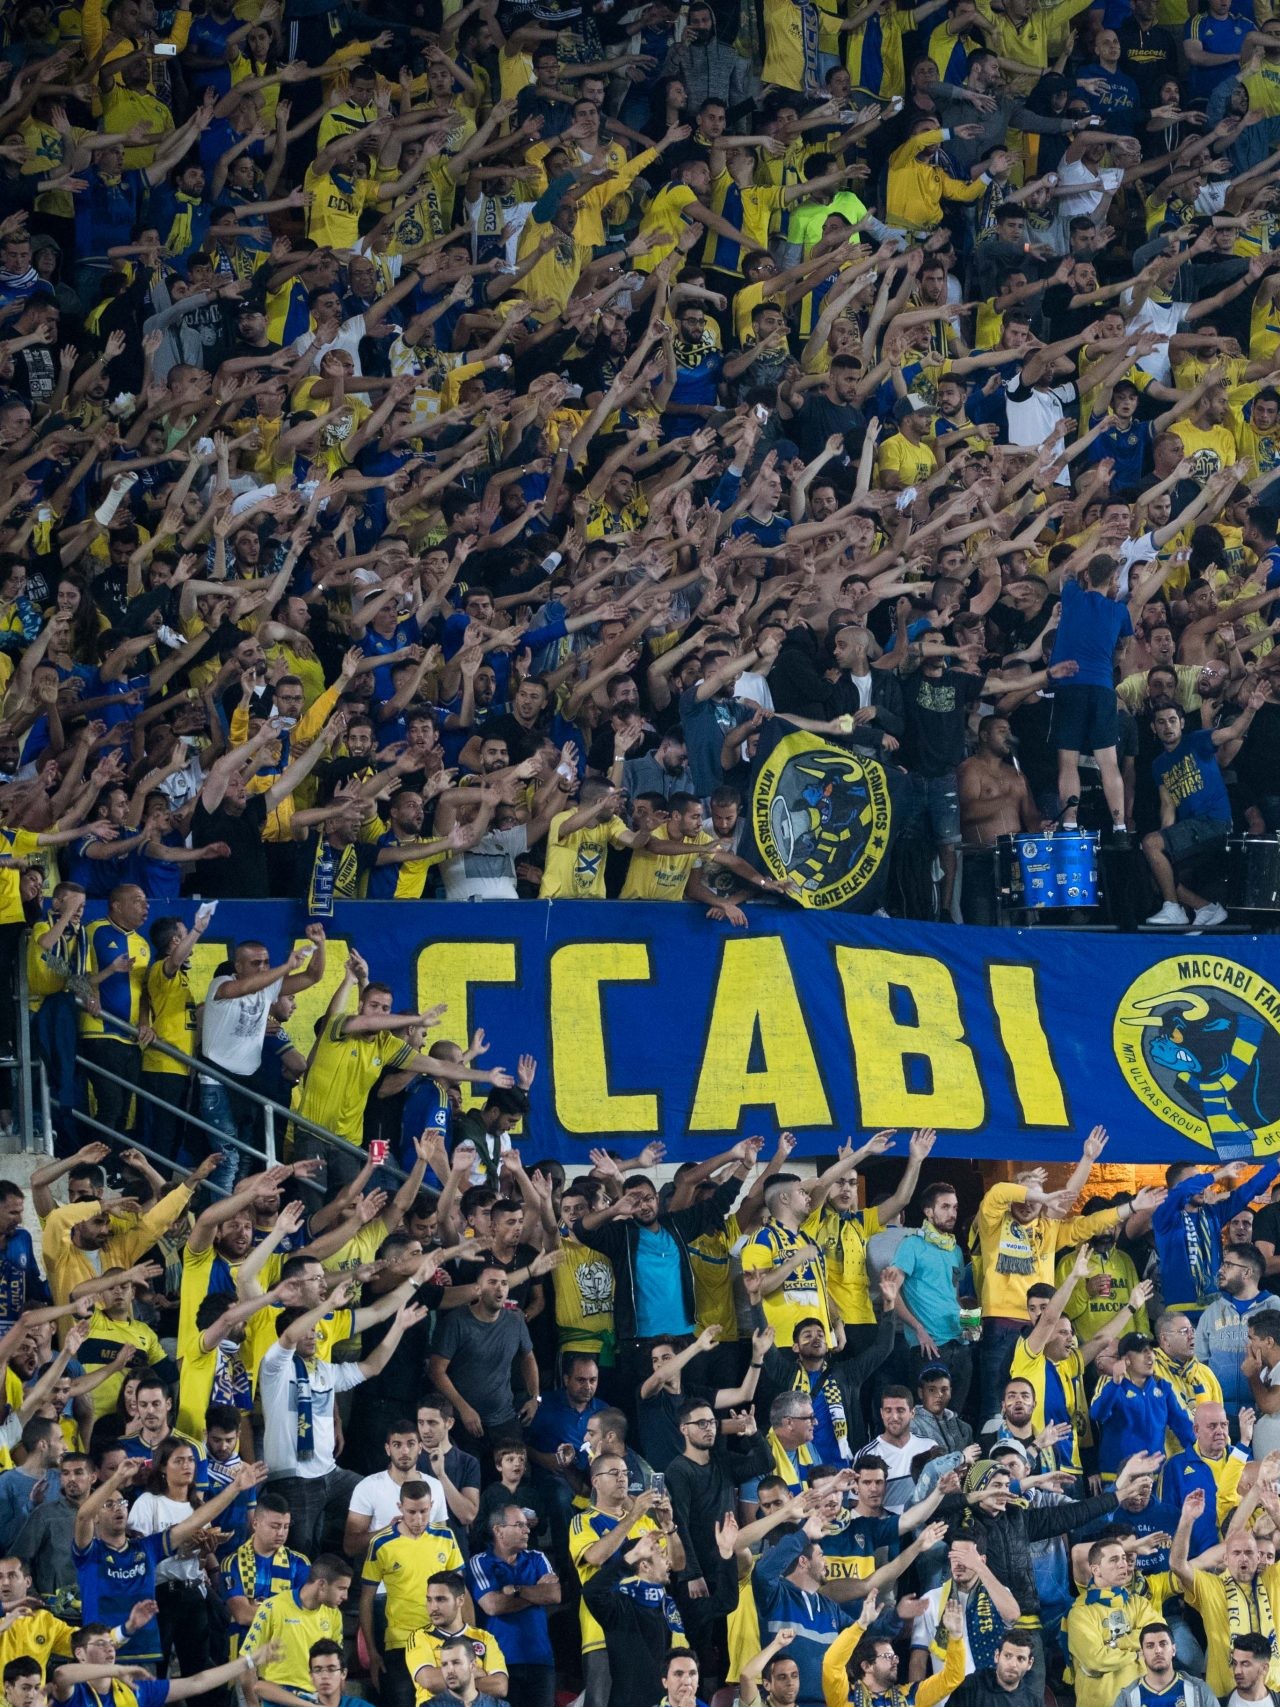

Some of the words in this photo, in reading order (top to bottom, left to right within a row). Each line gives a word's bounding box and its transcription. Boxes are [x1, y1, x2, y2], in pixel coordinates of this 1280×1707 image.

[758, 769, 775, 796] MTA
[868, 767, 887, 831] FANATICS
[756, 799, 771, 844] ULTRAS
[814, 888, 844, 907] GATE
[844, 855, 878, 896] ELEVEN
[1177, 960, 1253, 993] MACCABI
[1121, 1042, 1137, 1064] MTA
[1130, 1067, 1162, 1107] ULTRAS
[1162, 1105, 1203, 1135] GROUP
